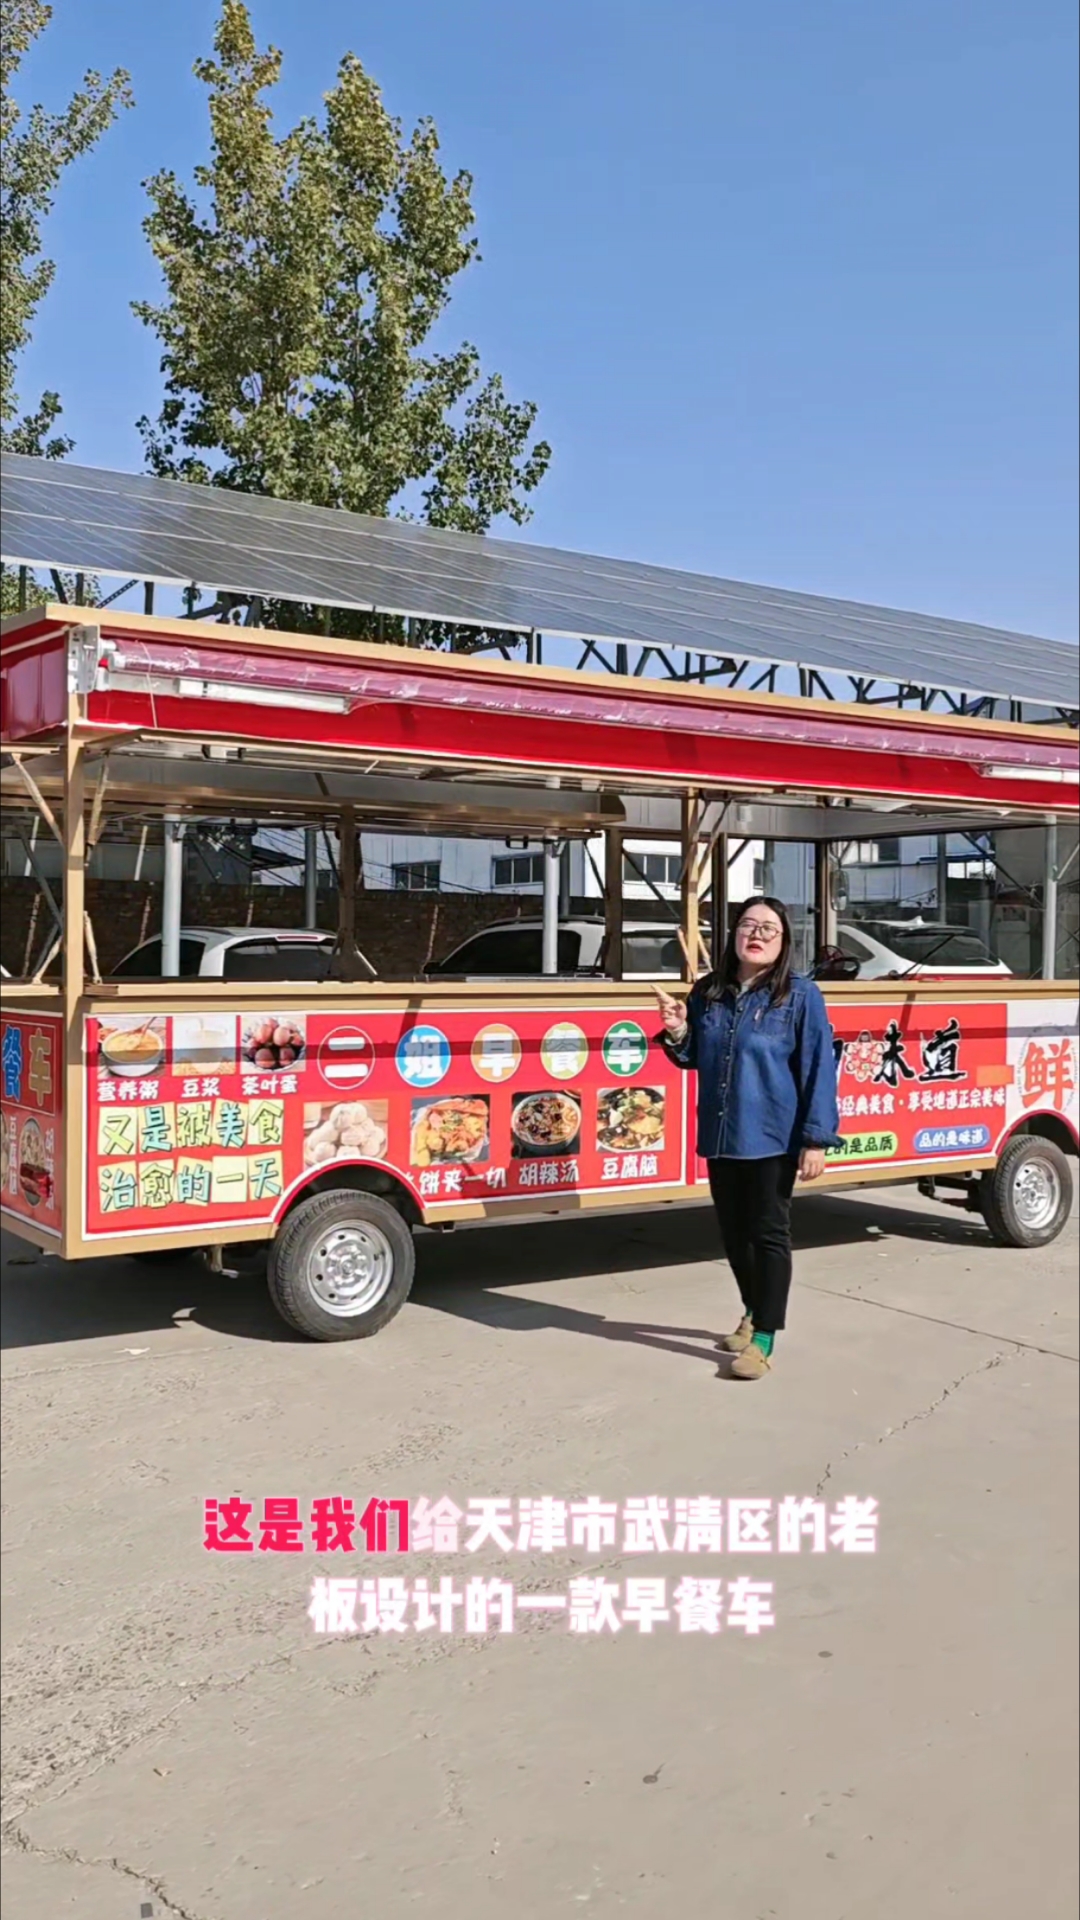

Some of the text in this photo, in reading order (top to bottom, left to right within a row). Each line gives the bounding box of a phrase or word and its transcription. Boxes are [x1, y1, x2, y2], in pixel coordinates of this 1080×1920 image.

[324, 1028, 643, 1080] 二姐早餐车
[241, 1074, 298, 1096] 茶叶蛋
[1021, 1037, 1075, 1111] 鲜
[97, 1079, 159, 1102] 营养粥
[181, 1078, 220, 1098] 豆浆
[102, 1101, 284, 1155] 又是被美食
[918, 1127, 984, 1149] 品的是味道
[824, 1134, 894, 1157] 的是品质
[518, 1159, 580, 1187] 胡辣汤
[601, 1154, 658, 1181] 豆腐脑
[100, 1157, 283, 1211] 治愈的一天
